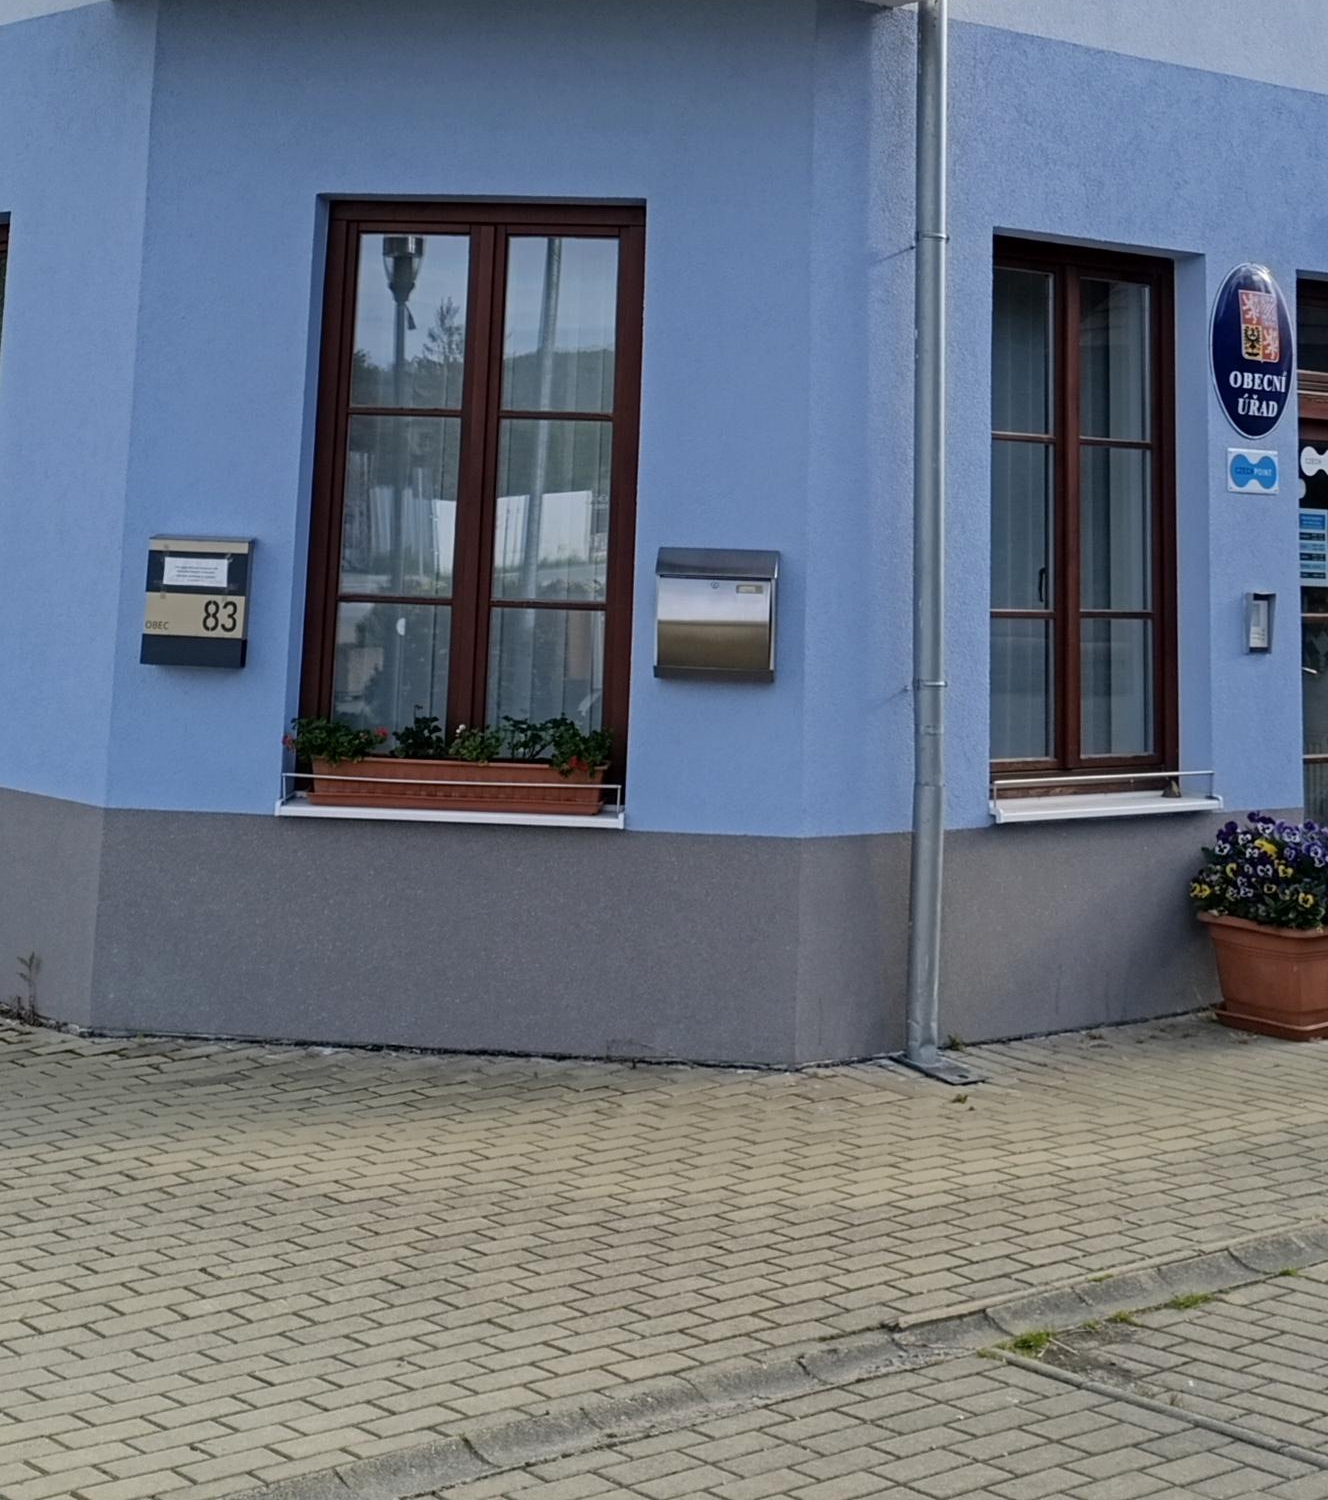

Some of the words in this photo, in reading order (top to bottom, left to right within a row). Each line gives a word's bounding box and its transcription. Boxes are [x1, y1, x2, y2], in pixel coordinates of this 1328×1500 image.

[1229, 371, 1288, 393] OBECNÍ
[1237, 395, 1278, 417] ÚŘAD
[145, 620, 170, 631] OBEC
[202, 599, 238, 633] 83
